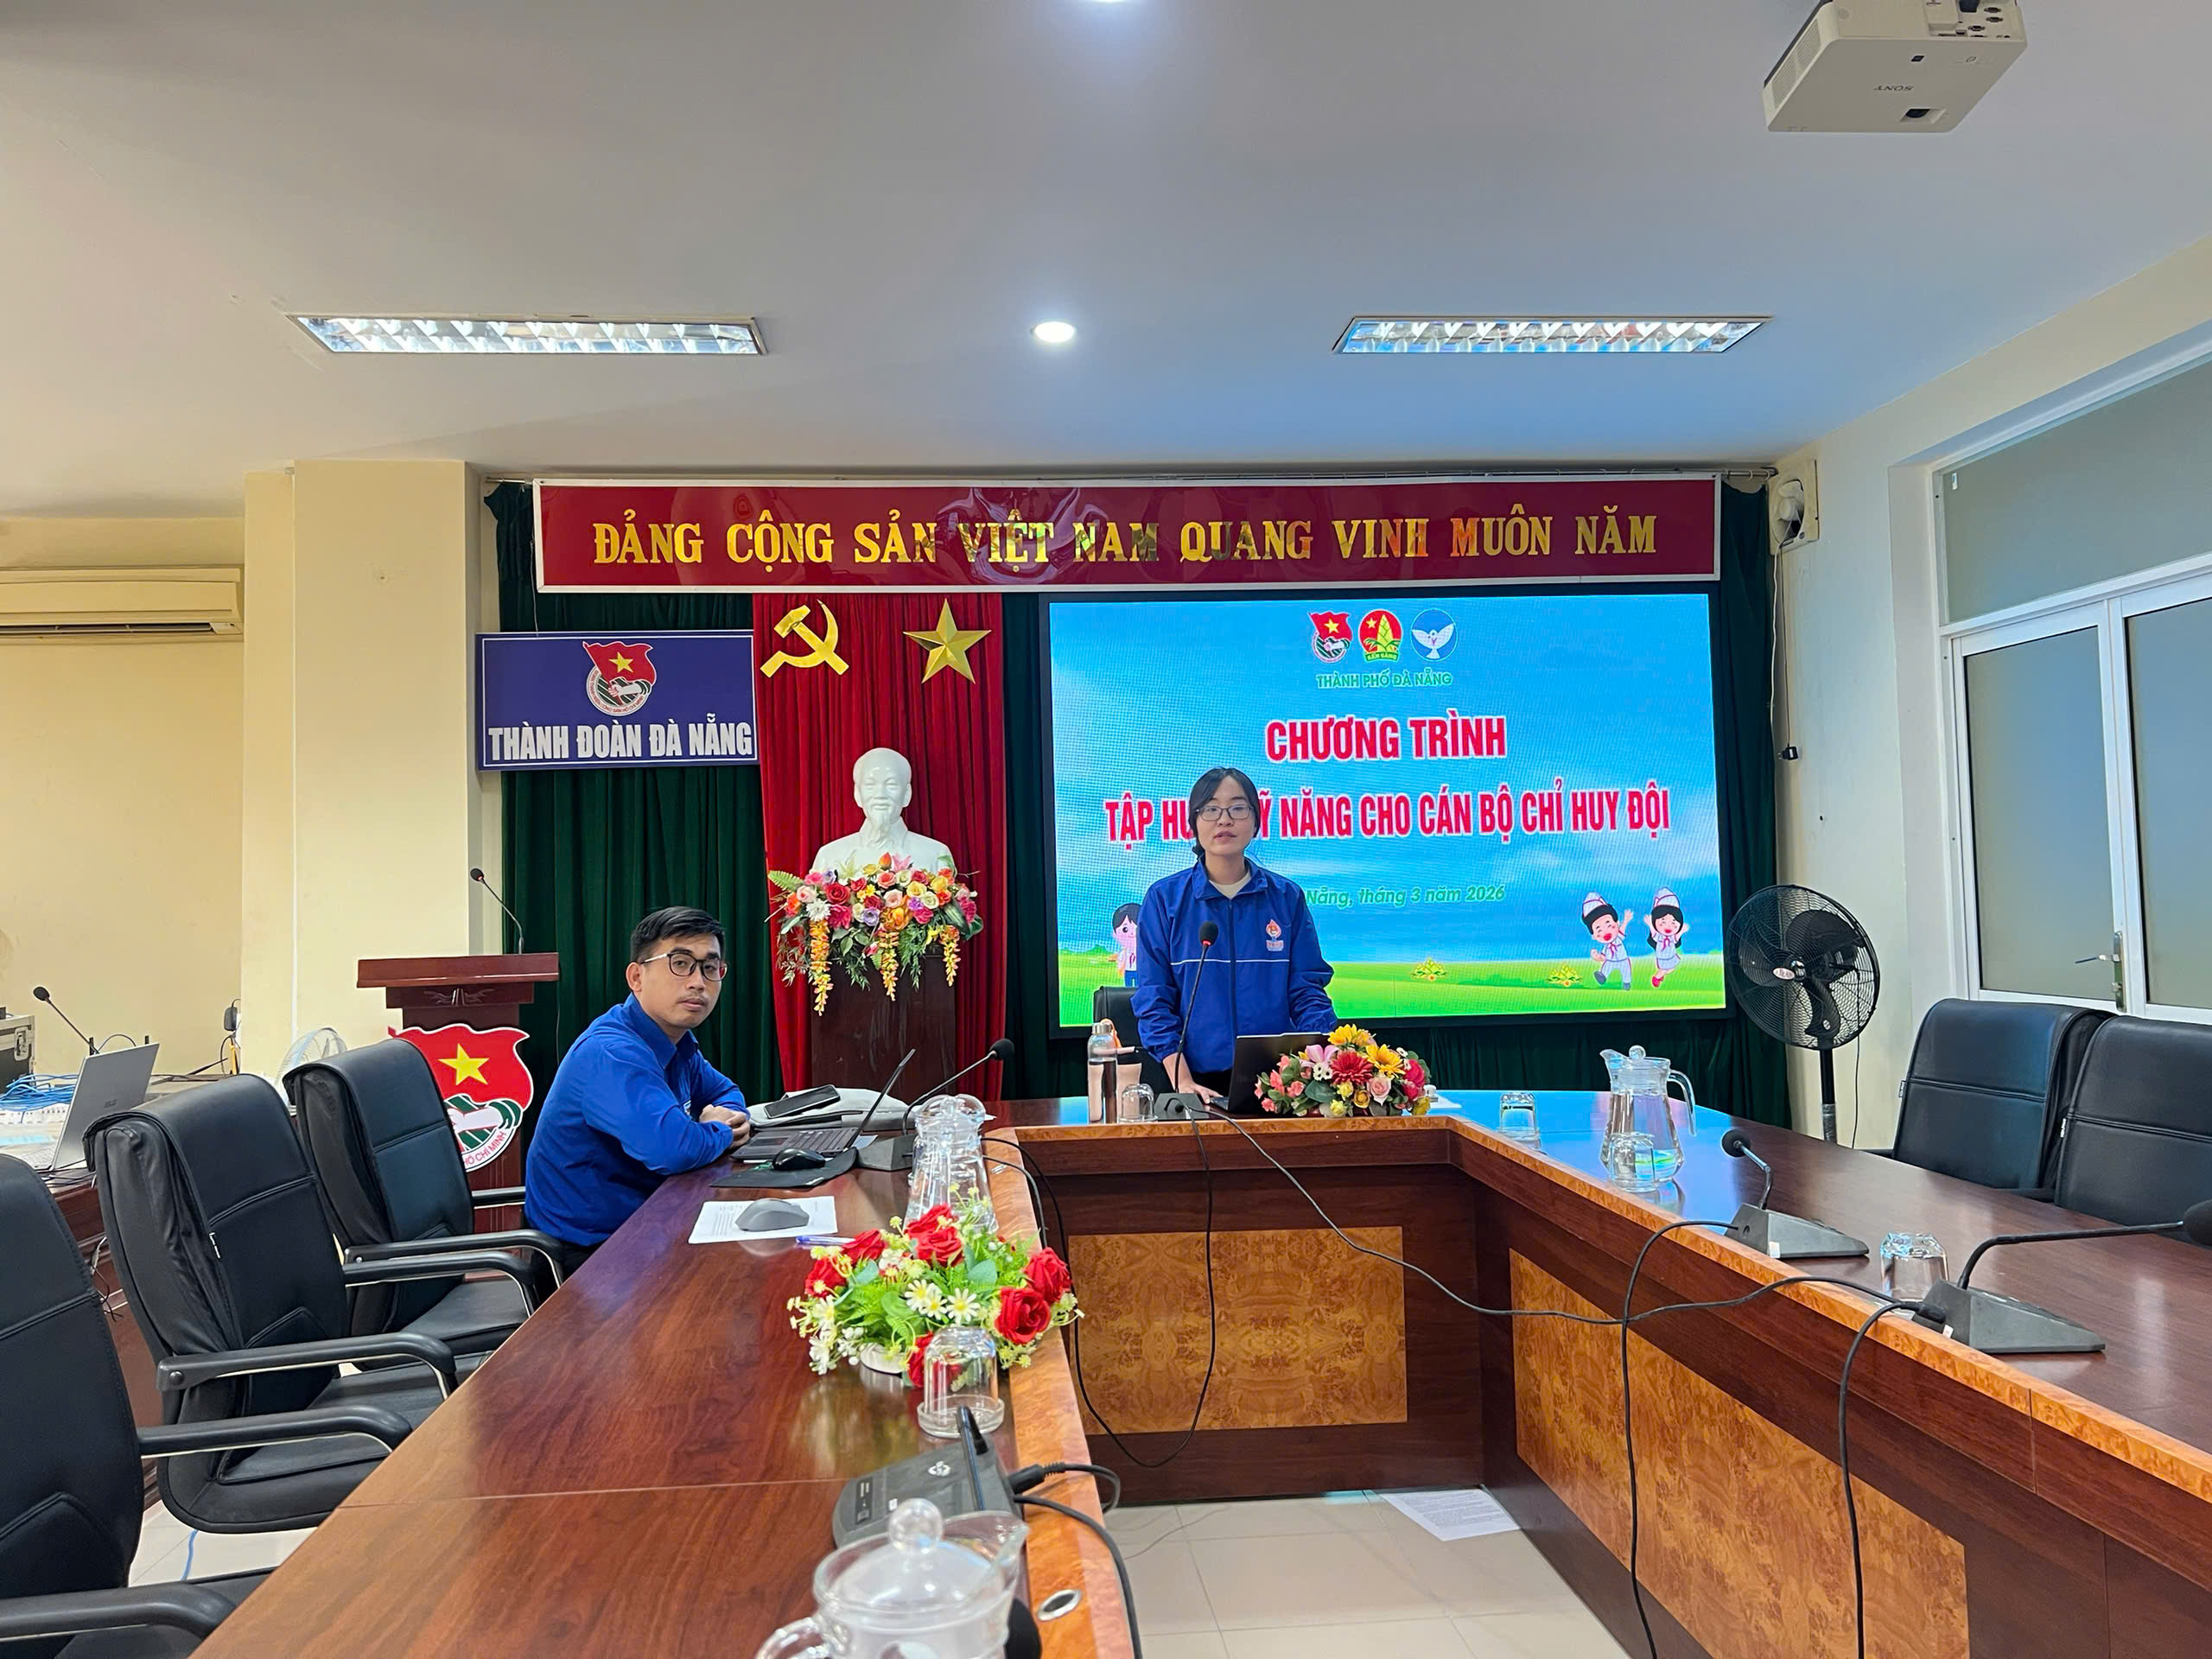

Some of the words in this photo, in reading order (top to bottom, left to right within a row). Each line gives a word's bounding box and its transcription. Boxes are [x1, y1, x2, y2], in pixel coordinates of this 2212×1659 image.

[593, 509, 704, 563] ĐẢNG
[727, 509, 835, 573] CỘNG
[854, 508, 938, 563] SẢN
[957, 508, 1055, 573] VIỆT
[1072, 521, 1159, 563] NAM
[1179, 520, 1311, 563] QUANG
[1332, 518, 1429, 559] VINH
[1450, 504, 1554, 557] MUÔN
[1574, 505, 1656, 554] NĂM
[1317, 671, 1360, 688] THÀNH
[1362, 669, 1390, 687] PHỐ
[1393, 670, 1412, 686] ĐÀ
[1414, 667, 1452, 685] NẴNG
[489, 721, 569, 760] THÀNH
[576, 720, 642, 758] ĐOÀN
[649, 719, 683, 757] ĐÀ
[689, 712, 753, 756] NẴNG
[1267, 715, 1399, 761] CHƯƠNG
[1410, 711, 1504, 757] TRÌNH
[1106, 792, 1154, 849] TẬP
[1162, 800, 1194, 840] HU
[1281, 788, 1351, 837] NĂNG
[1361, 794, 1410, 836] CHO
[1421, 784, 1471, 834] CÁN
[1480, 785, 1513, 842] BỘ
[1522, 778, 1563, 832] CHỈ
[1572, 791, 1619, 830] HUY
[1627, 781, 1669, 838] ĐỘI
[1359, 887, 1406, 906] tháng
[1410, 887, 1421, 902] 3
[1426, 887, 1461, 902] năm
[1465, 885, 1505, 901] 2026
[488, 1131, 507, 1152] MINH
